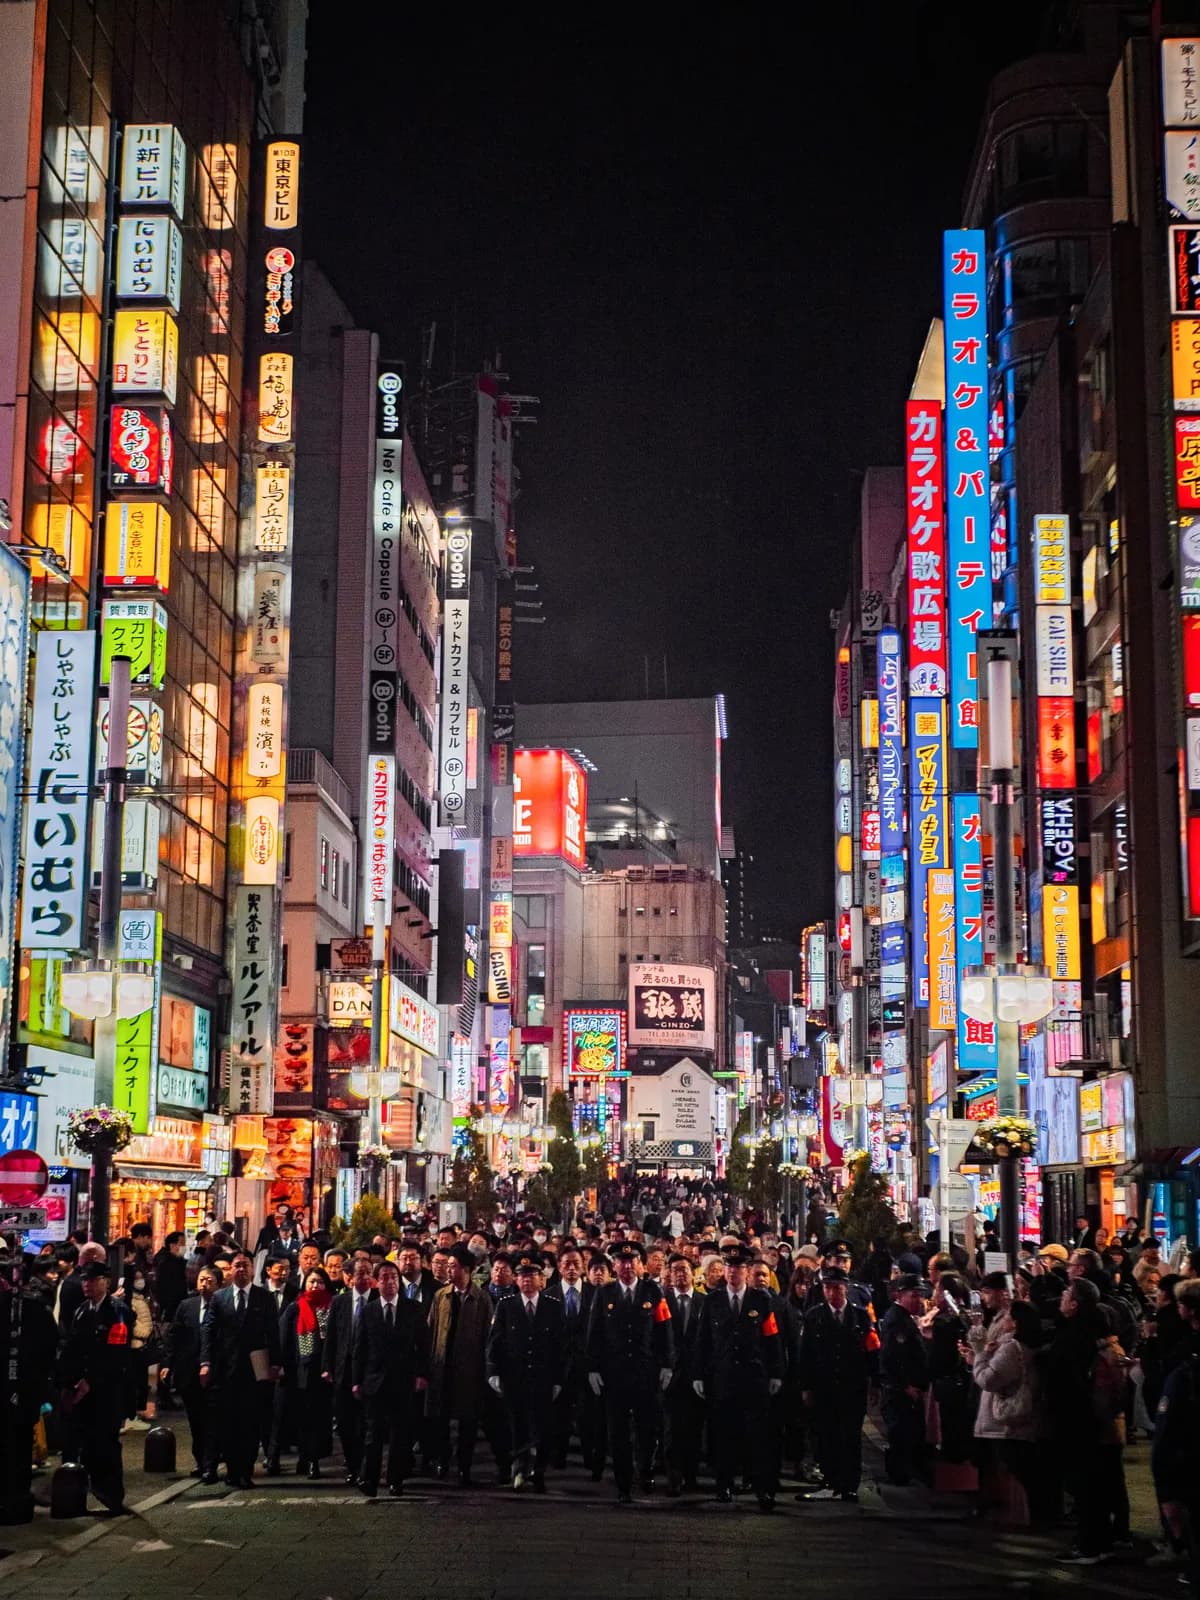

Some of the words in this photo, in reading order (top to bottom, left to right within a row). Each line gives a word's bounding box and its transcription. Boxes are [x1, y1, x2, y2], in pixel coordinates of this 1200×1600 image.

[136, 129, 160, 199] 川新ビル
[274, 159, 292, 221] 東京ビル
[379, 372, 403, 433] Booth
[120, 411, 149, 470] おすすめ
[383, 448, 396, 473] Net
[113, 473, 129, 483] 7F
[382, 479, 395, 516] Cafe
[382, 521, 394, 532] &
[910, 411, 942, 652] カラオケ歌広場
[379, 537, 395, 601] Capsule
[447, 532, 469, 589] Booth
[451, 608, 463, 680] ネットカフェ
[51, 638, 75, 762] しゃぶしゃぶ
[372, 679, 395, 742] Booth
[451, 684, 461, 696] &
[449, 700, 461, 749] カプセル
[374, 772, 388, 827] カラオケ
[32, 767, 79, 937] にいむら
[1055, 798, 1074, 871] AGEHA
[246, 893, 262, 954] 喫茶室
[494, 904, 509, 933] 麻雀
[124, 945, 148, 954] 買取
[490, 951, 511, 1000] CASINO
[240, 962, 265, 1057] ルノアール
